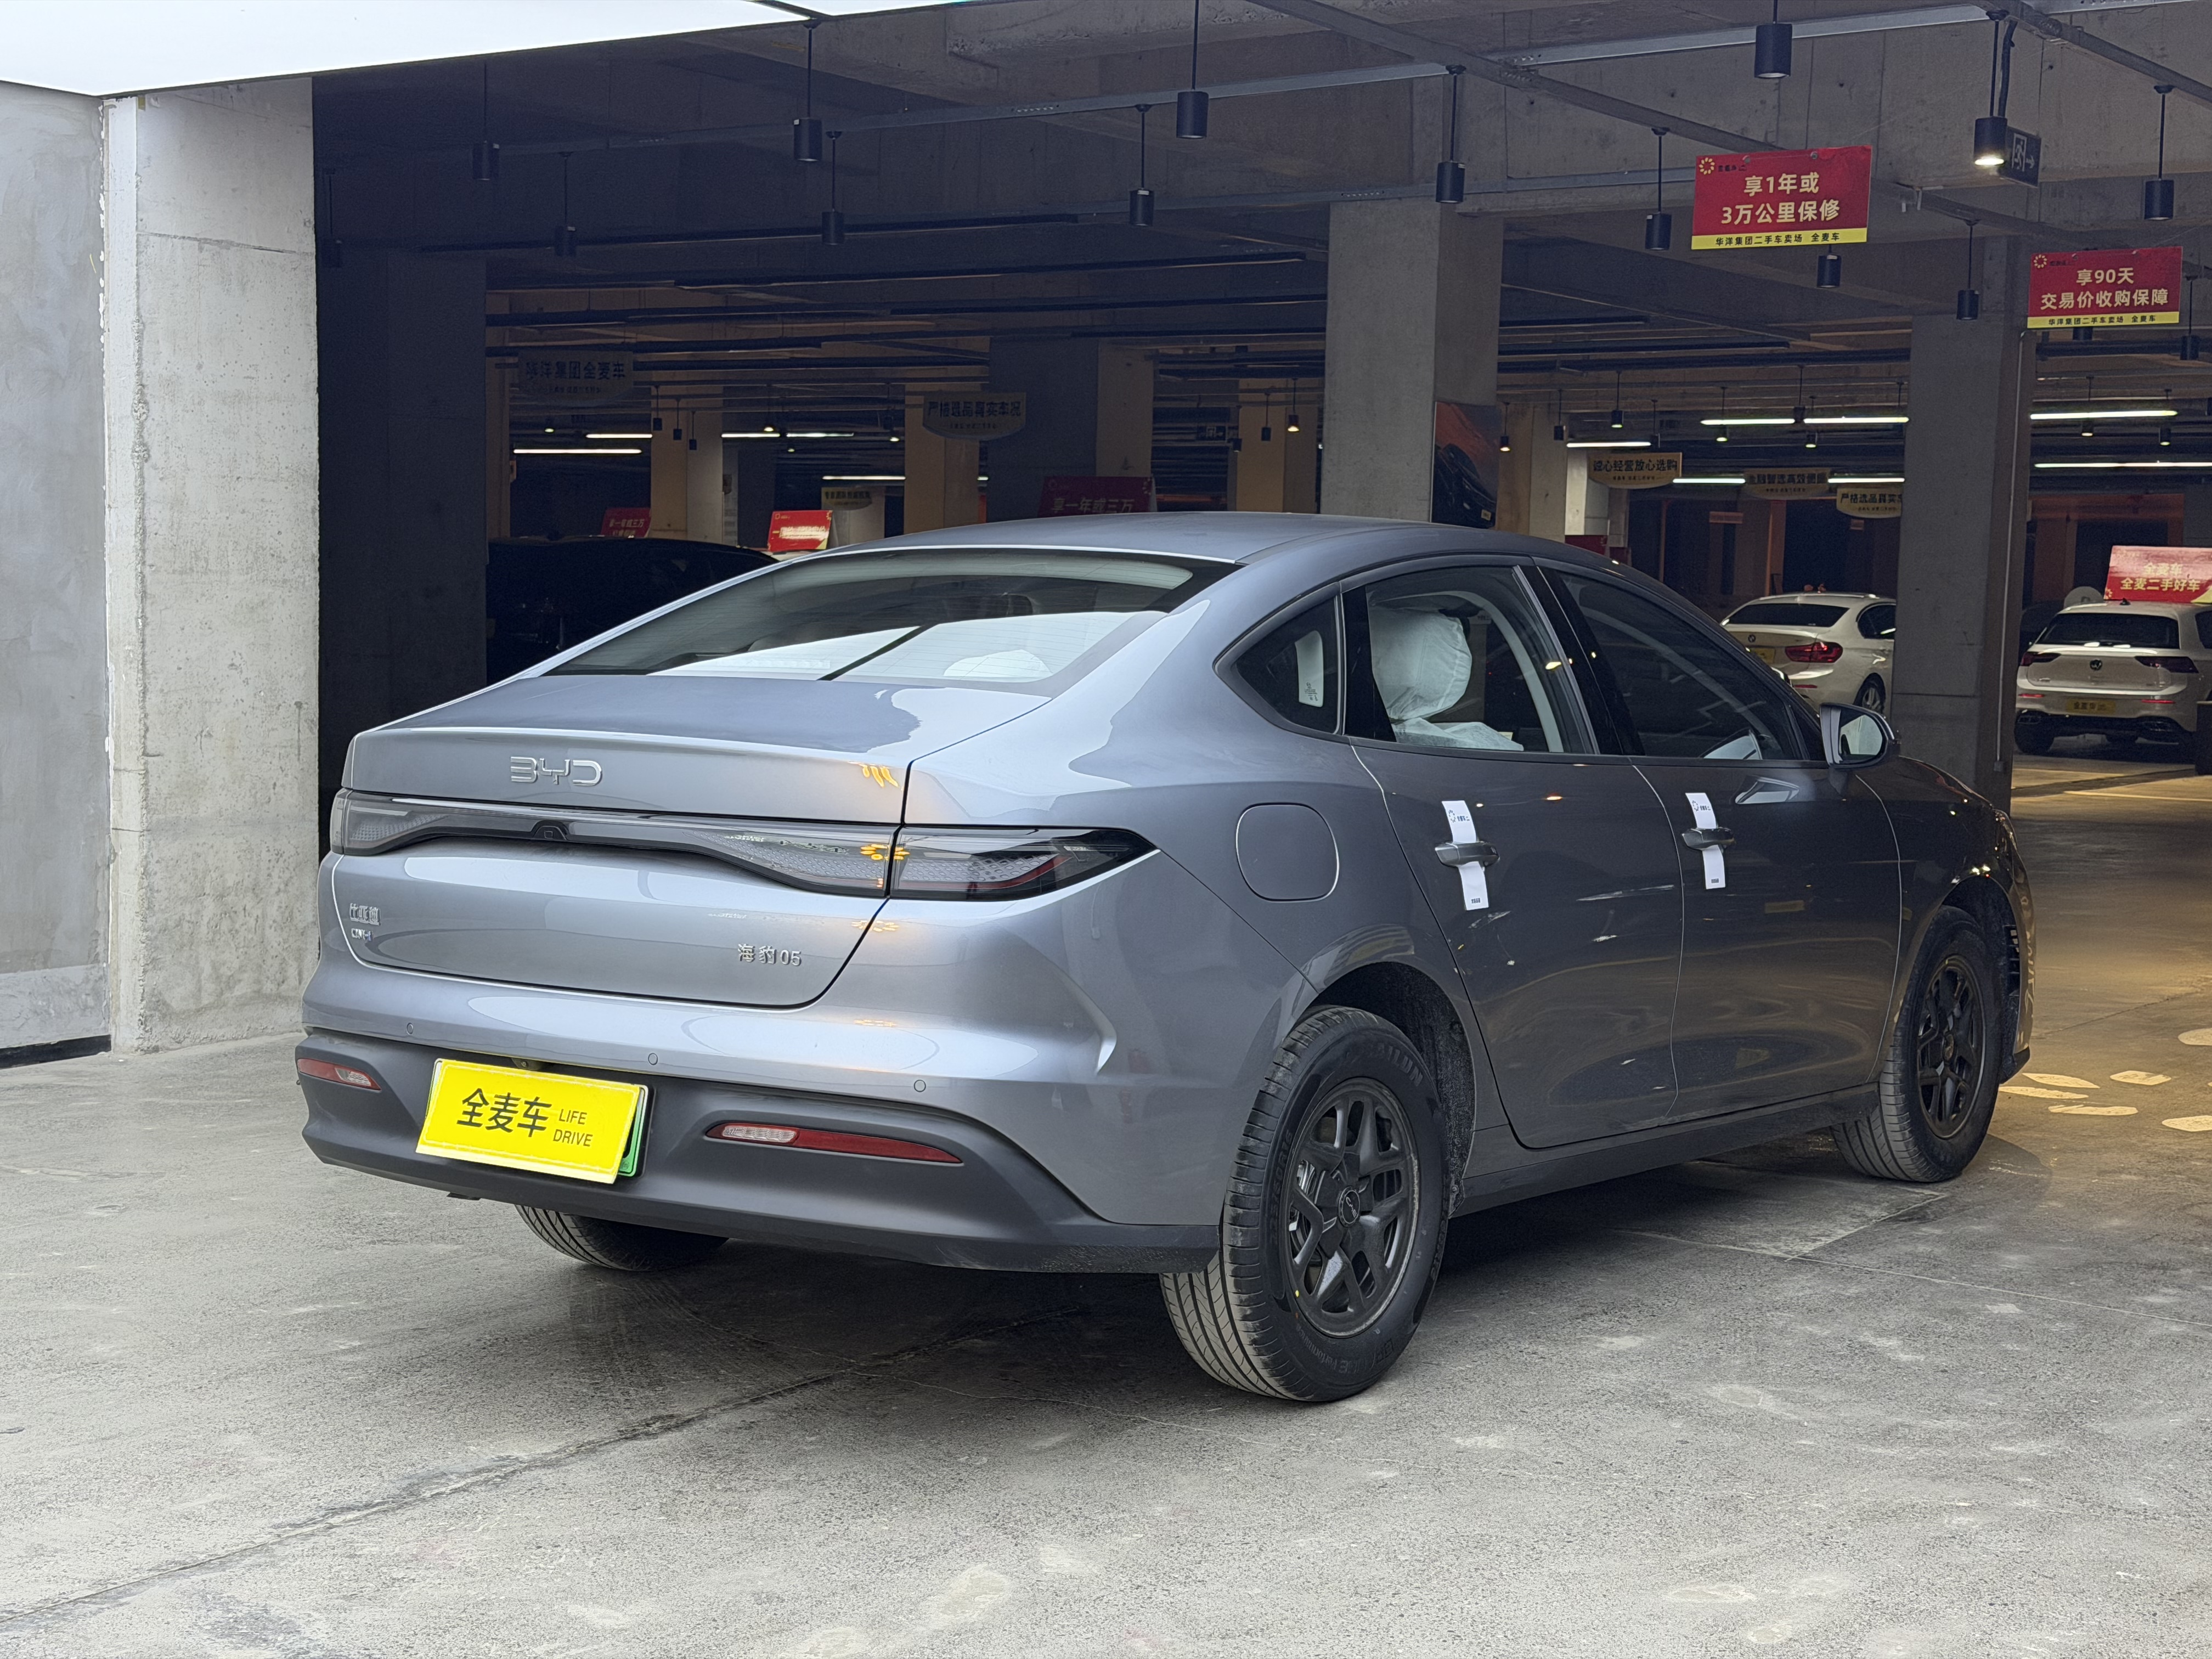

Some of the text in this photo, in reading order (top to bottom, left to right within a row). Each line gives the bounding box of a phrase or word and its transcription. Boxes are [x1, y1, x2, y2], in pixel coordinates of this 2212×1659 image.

[1744, 172, 1819, 197] 享1年或
[1721, 199, 1840, 224] 3万公里保修
[1716, 233, 1840, 246] 华洋集团二手车卖场 全麦车
[2076, 268, 2134, 286] 享90天
[2040, 289, 2169, 310] 交易价收购保障
[2143, 562, 2183, 576] 全麦车
[2120, 577, 2201, 592] 全麦二手好车
[510, 756, 602, 786] BYD
[456, 1088, 552, 1138] 全麦车
[558, 1108, 588, 1125] LIFE
[552, 1129, 594, 1147] DRIVE
